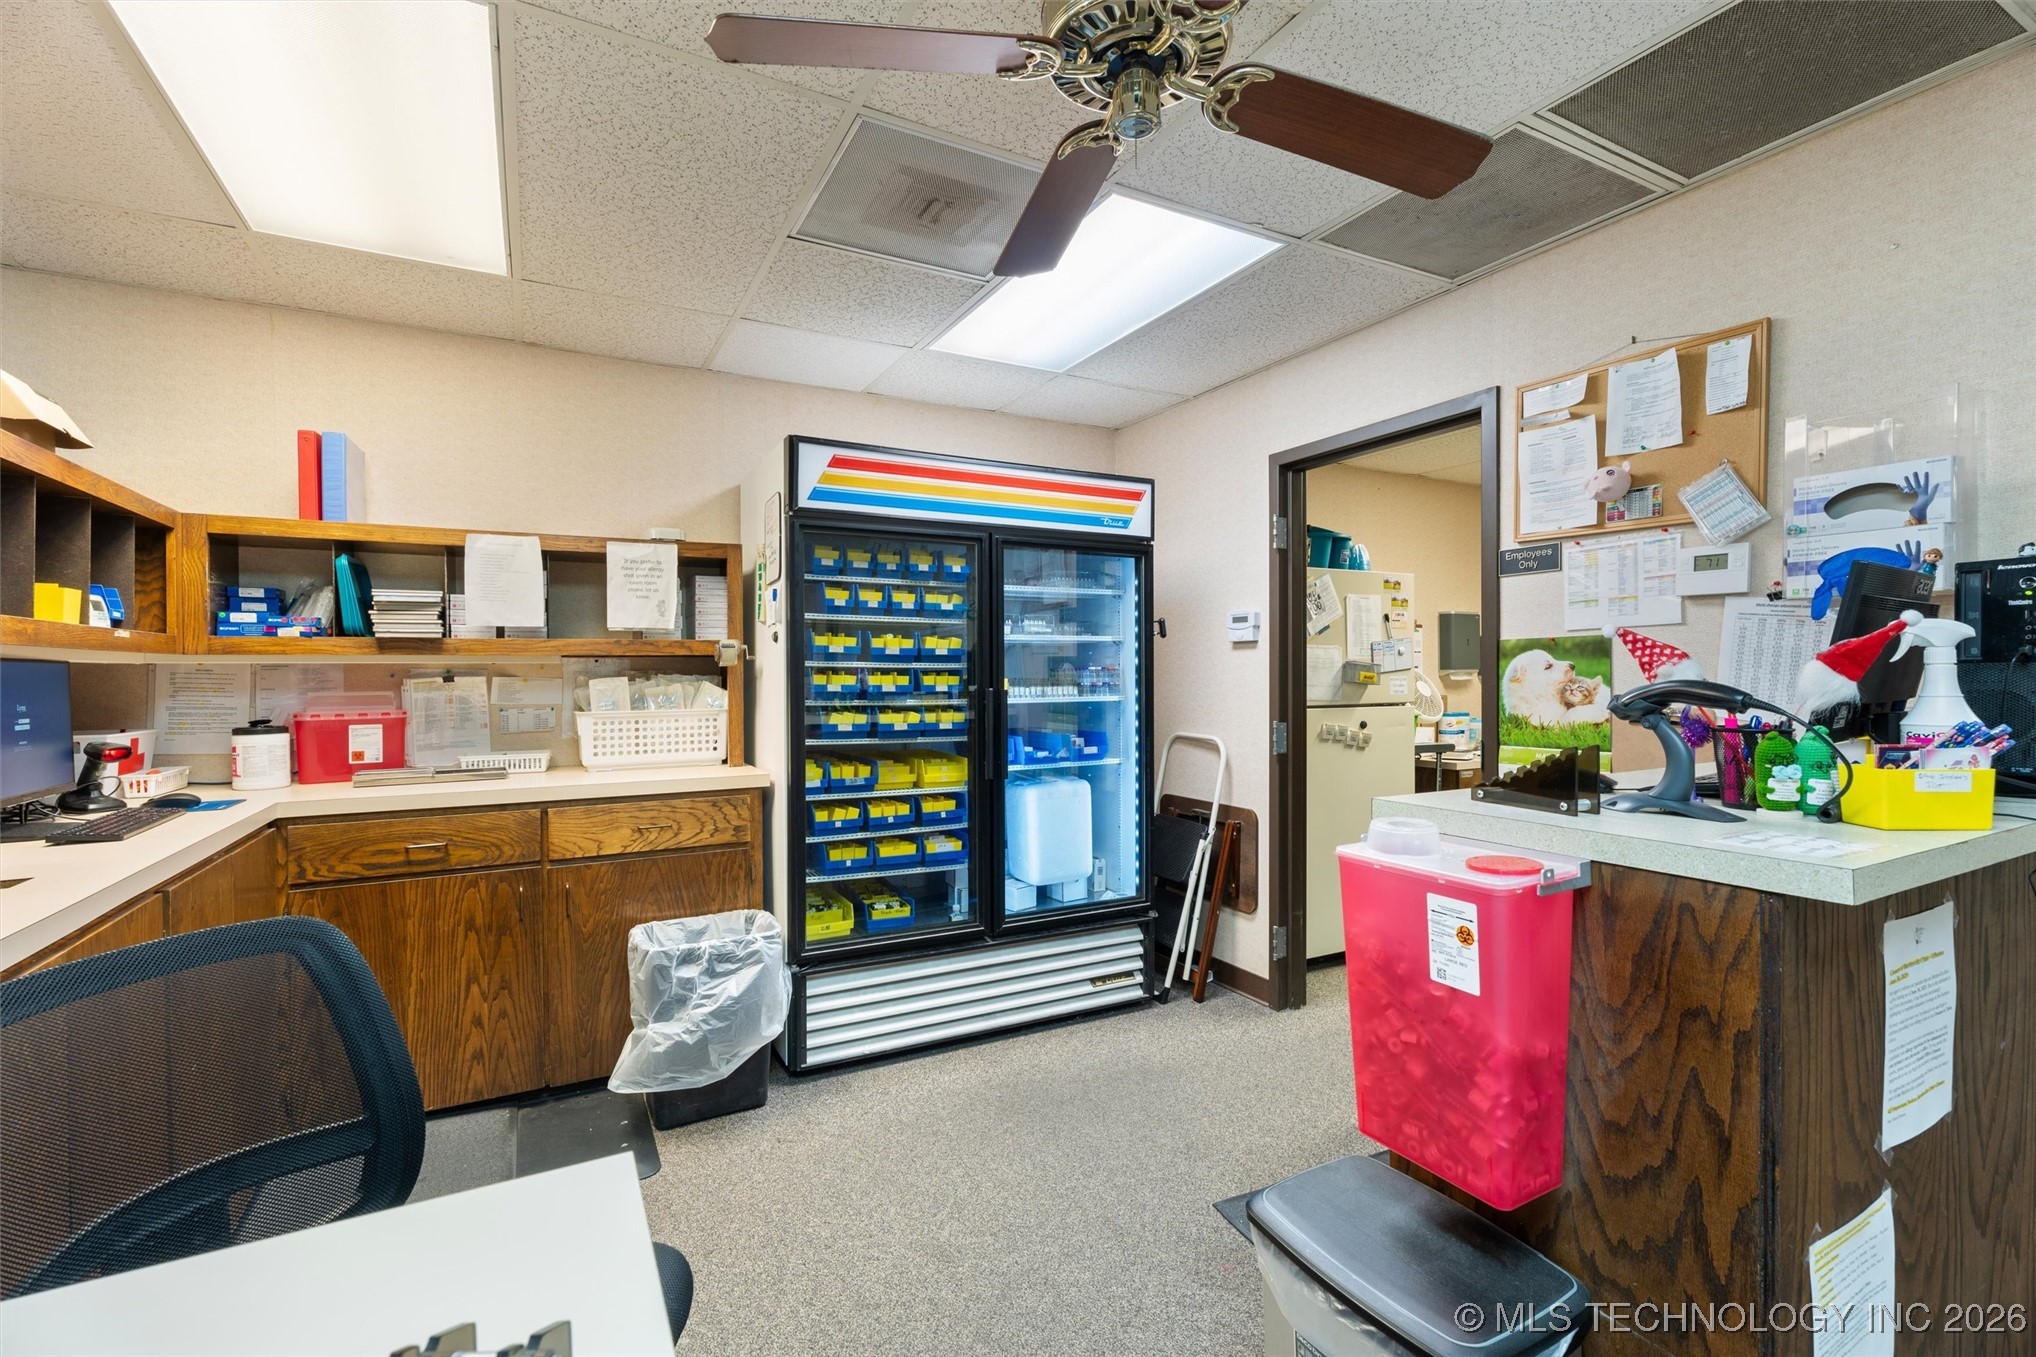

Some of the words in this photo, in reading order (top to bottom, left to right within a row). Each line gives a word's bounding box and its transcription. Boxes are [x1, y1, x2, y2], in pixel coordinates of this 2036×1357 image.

[1505, 548, 1553, 560] Employees
[1518, 560, 1538, 569] Only
[1706, 558, 1720, 567] 71
[1916, 578, 1933, 595] acer
